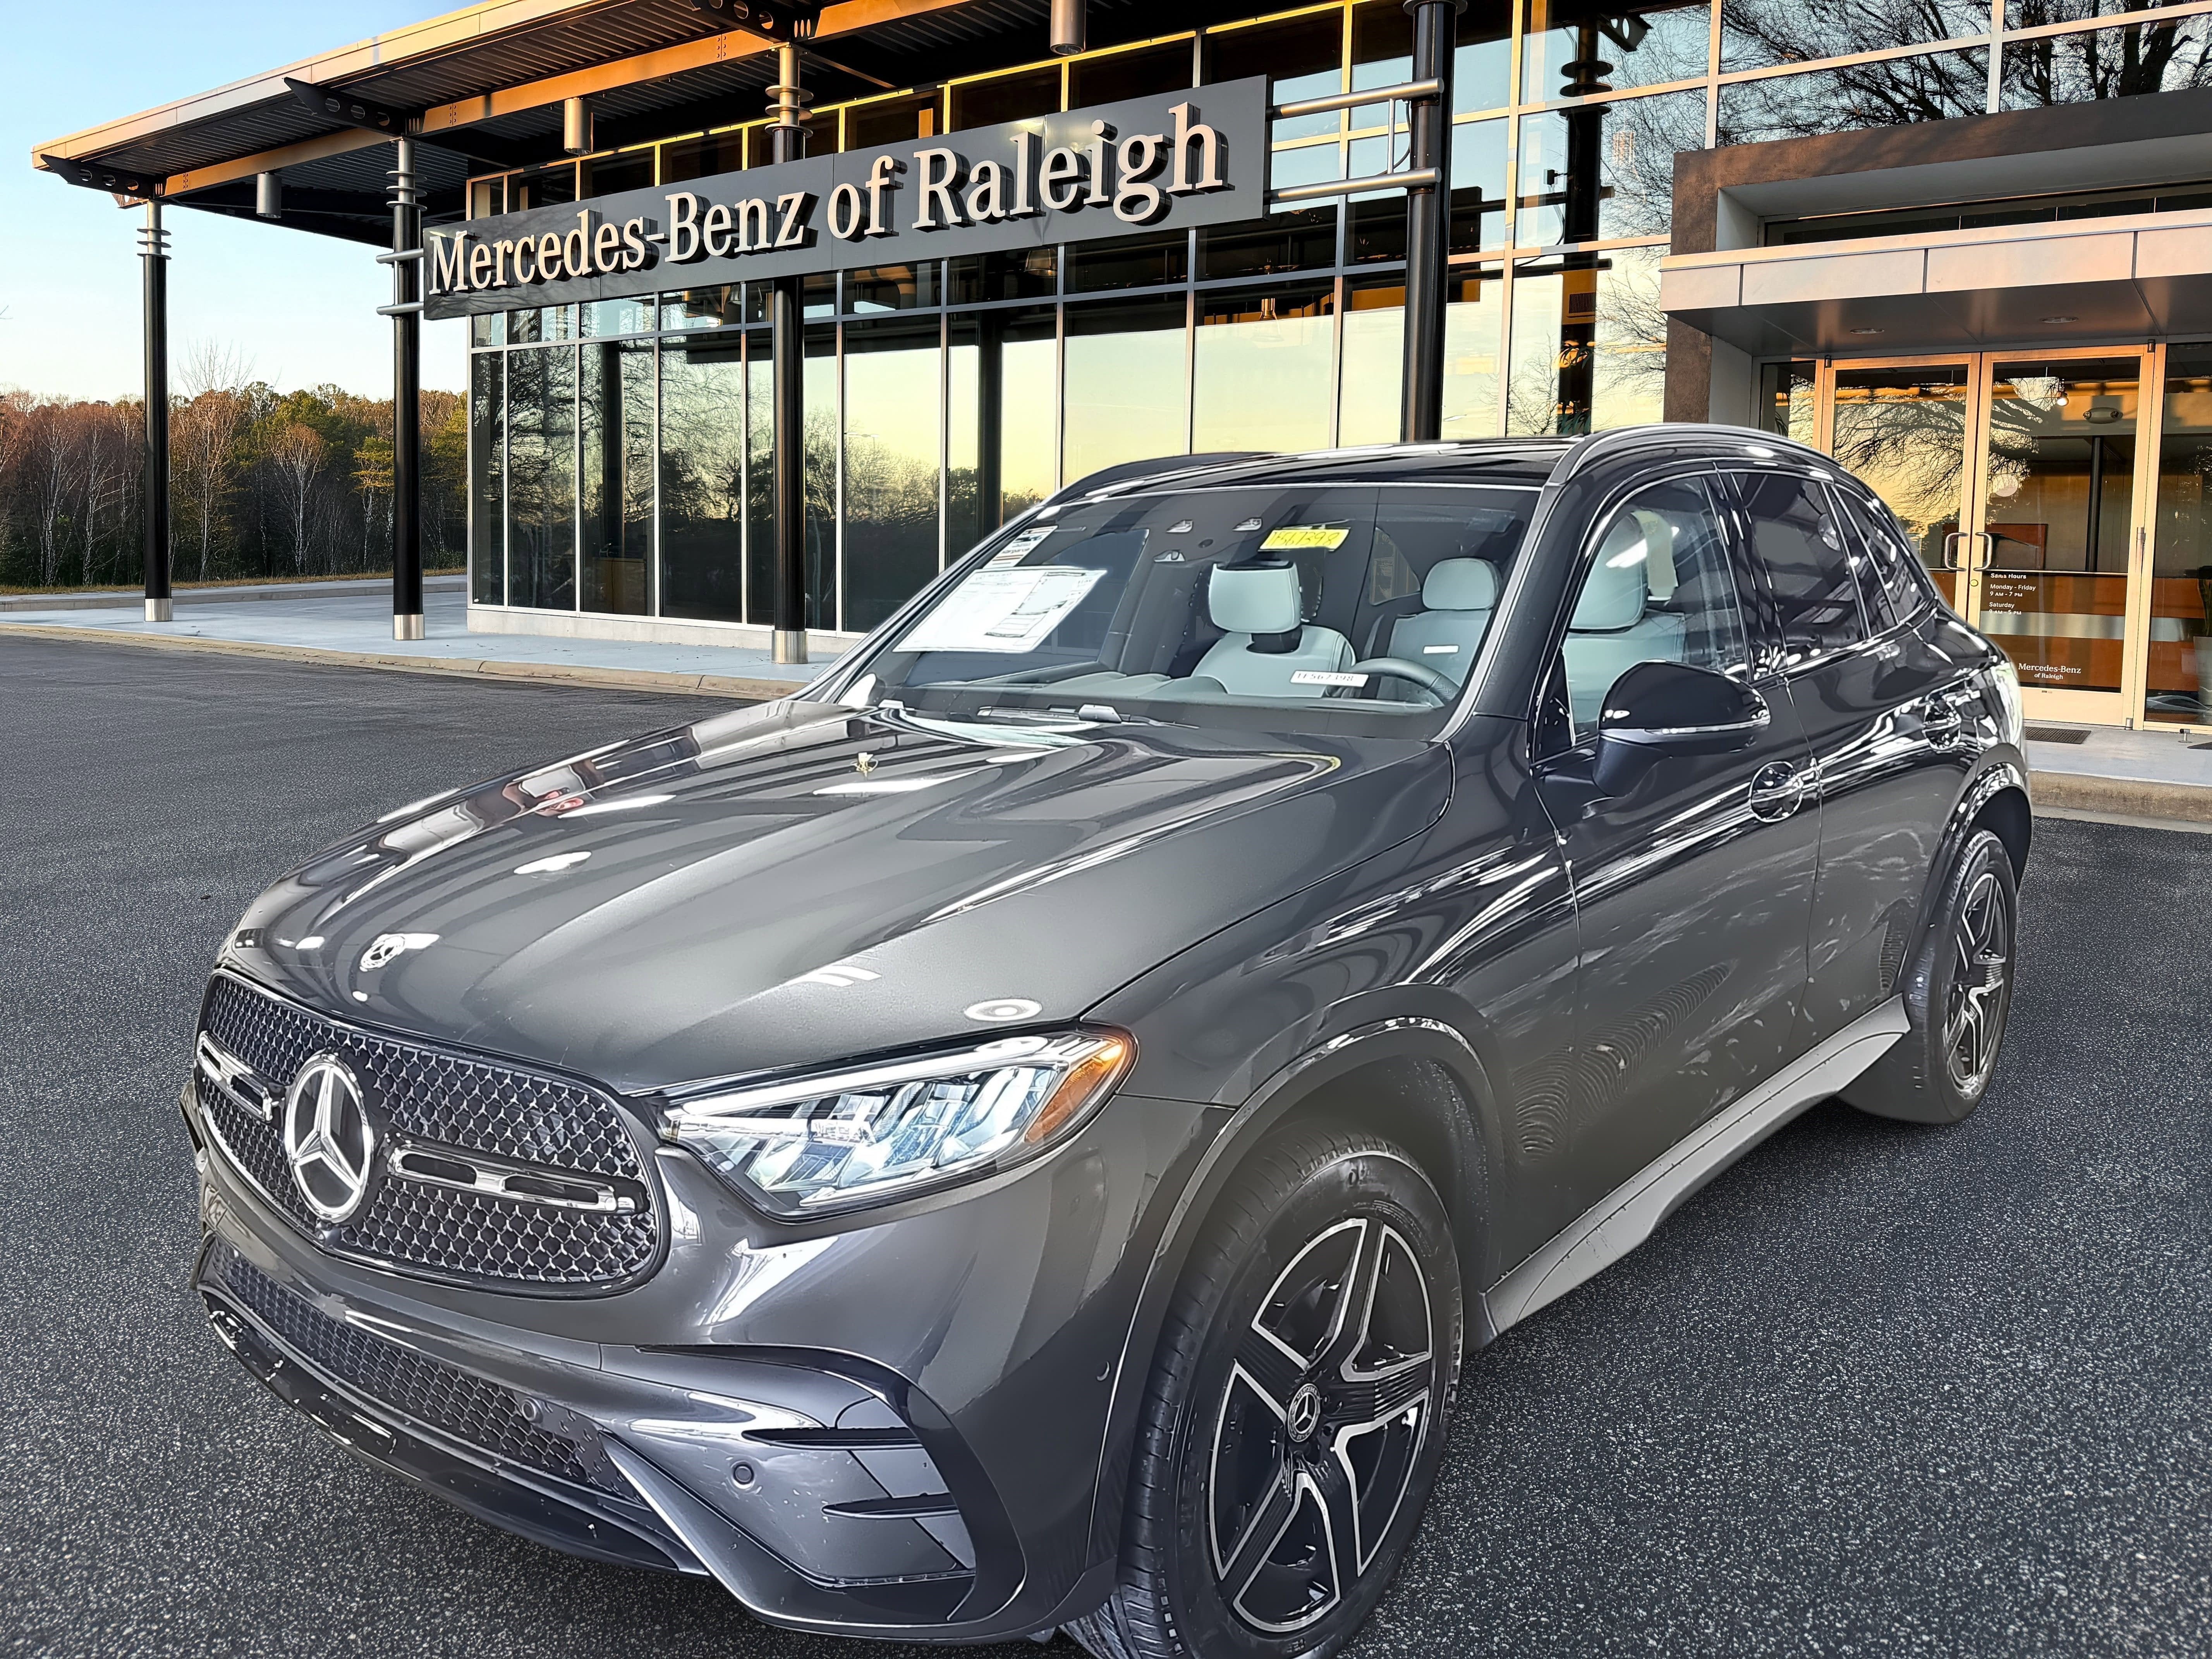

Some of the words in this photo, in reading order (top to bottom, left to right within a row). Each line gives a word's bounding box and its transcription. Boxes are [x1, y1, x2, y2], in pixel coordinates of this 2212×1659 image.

[428, 191, 807, 295] Mercedes-Benz
[827, 155, 895, 239] of
[912, 101, 1224, 223] Raleigh
[2018, 663, 2081, 674] Mercedes-Benz
